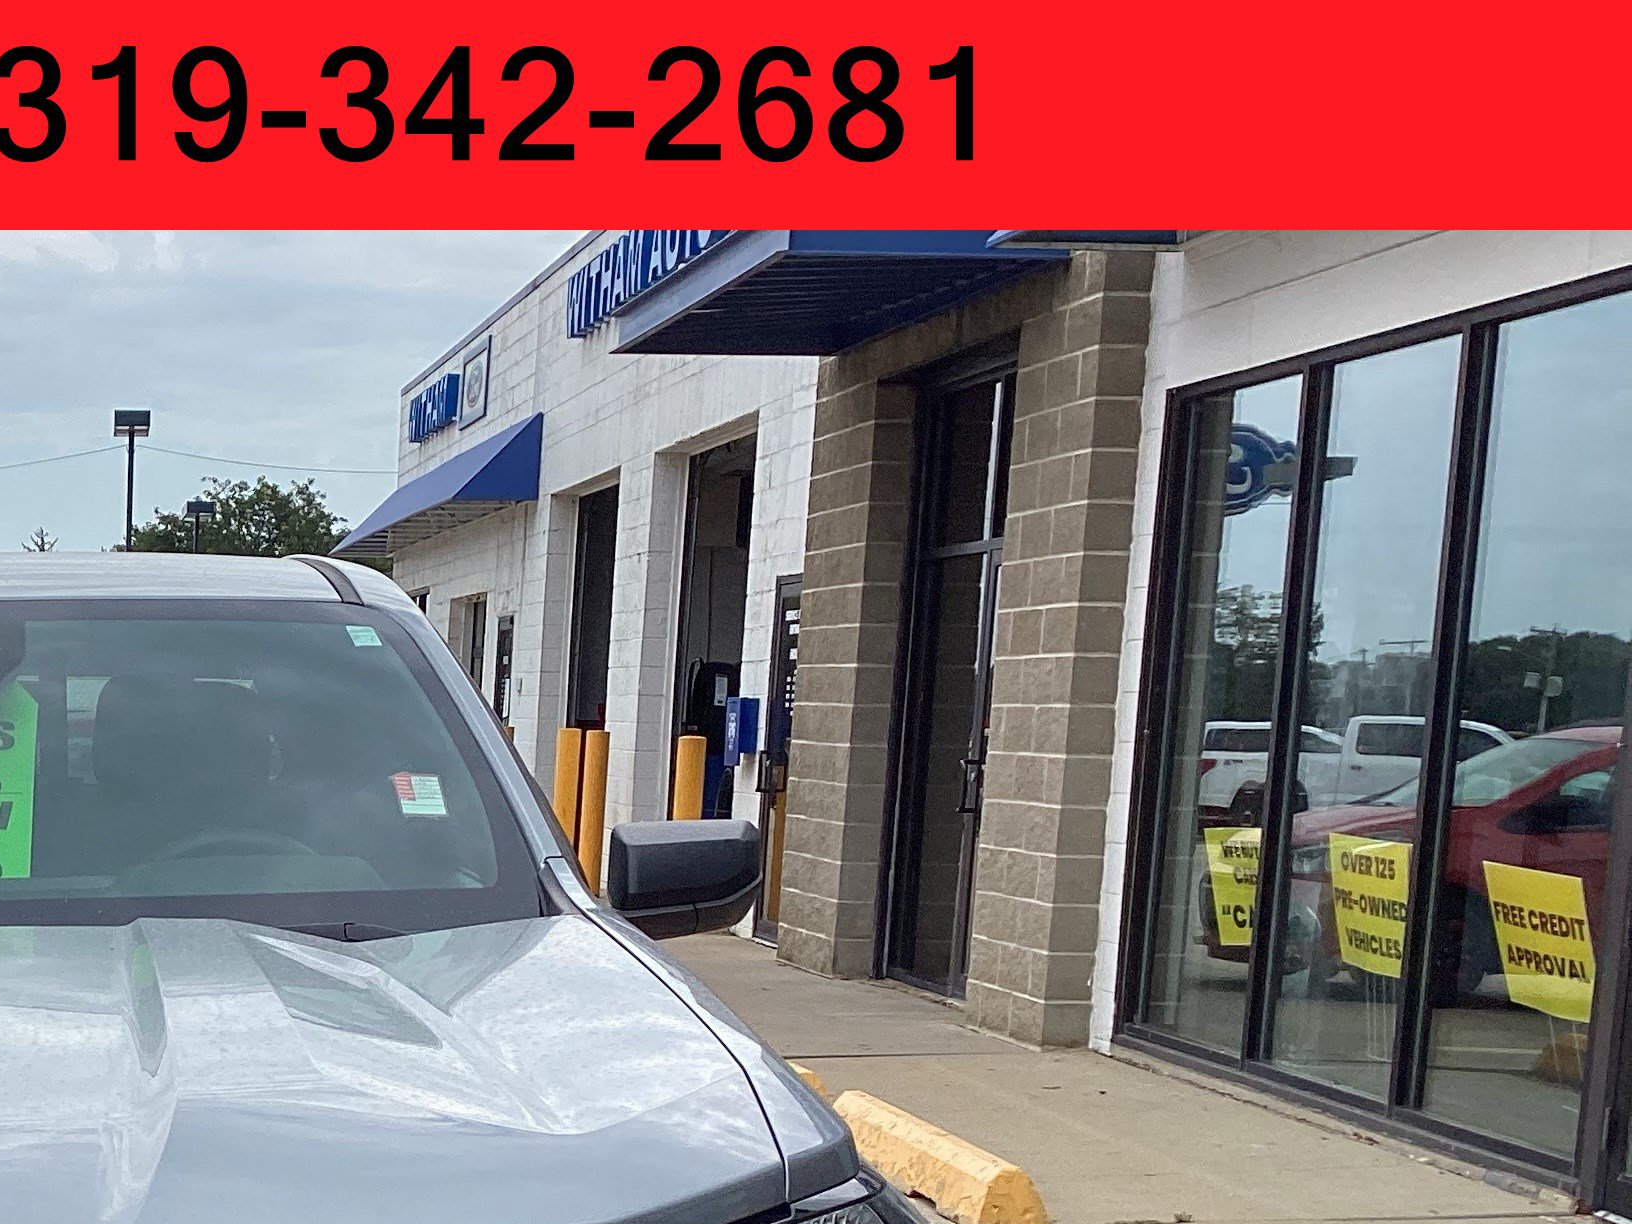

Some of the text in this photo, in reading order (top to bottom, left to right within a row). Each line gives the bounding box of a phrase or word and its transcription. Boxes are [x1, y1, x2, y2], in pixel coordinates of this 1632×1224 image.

[567, 230, 644, 338] WITHAM
[1341, 851, 1396, 880] OVER 125
[1334, 887, 1407, 922] PRE-OWNED
[1493, 901, 1585, 941] FREE CREDIT
[1345, 926, 1402, 960] VEHICLES
[1507, 943, 1591, 983] APPROVAL
